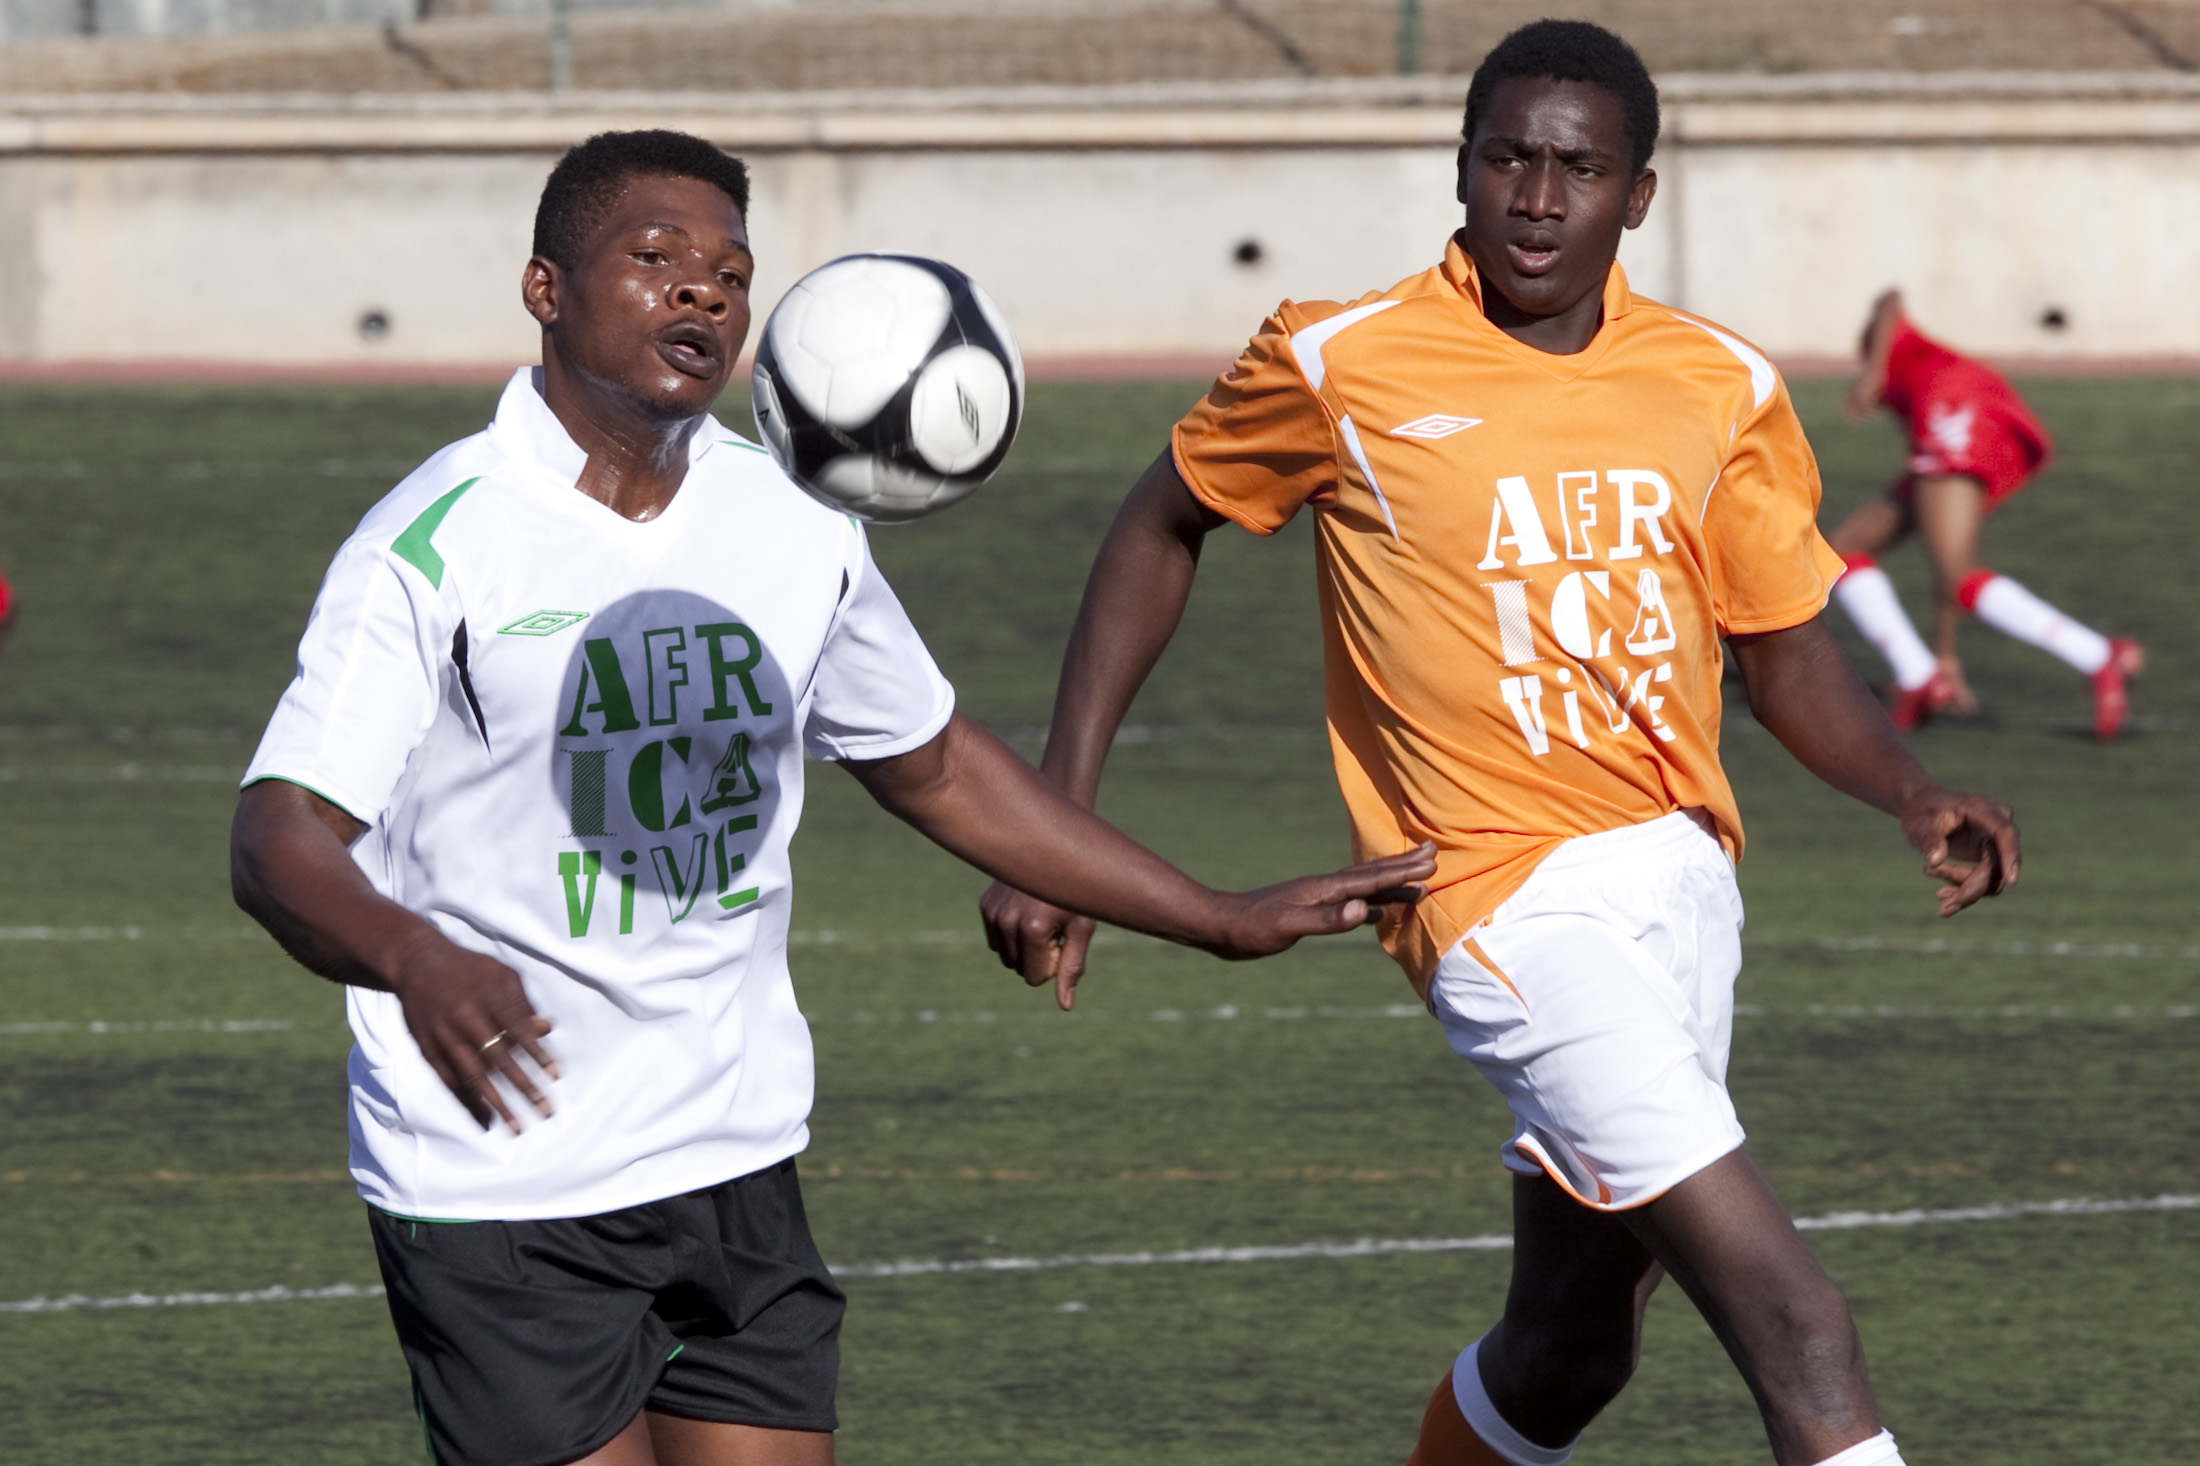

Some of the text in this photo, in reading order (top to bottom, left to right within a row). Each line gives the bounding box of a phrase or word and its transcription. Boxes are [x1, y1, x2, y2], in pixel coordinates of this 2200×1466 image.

[1477, 469, 1675, 571] AFR
[1480, 568, 1676, 667] ICA
[559, 622, 773, 737] AFR
[558, 732, 762, 839] ICA
